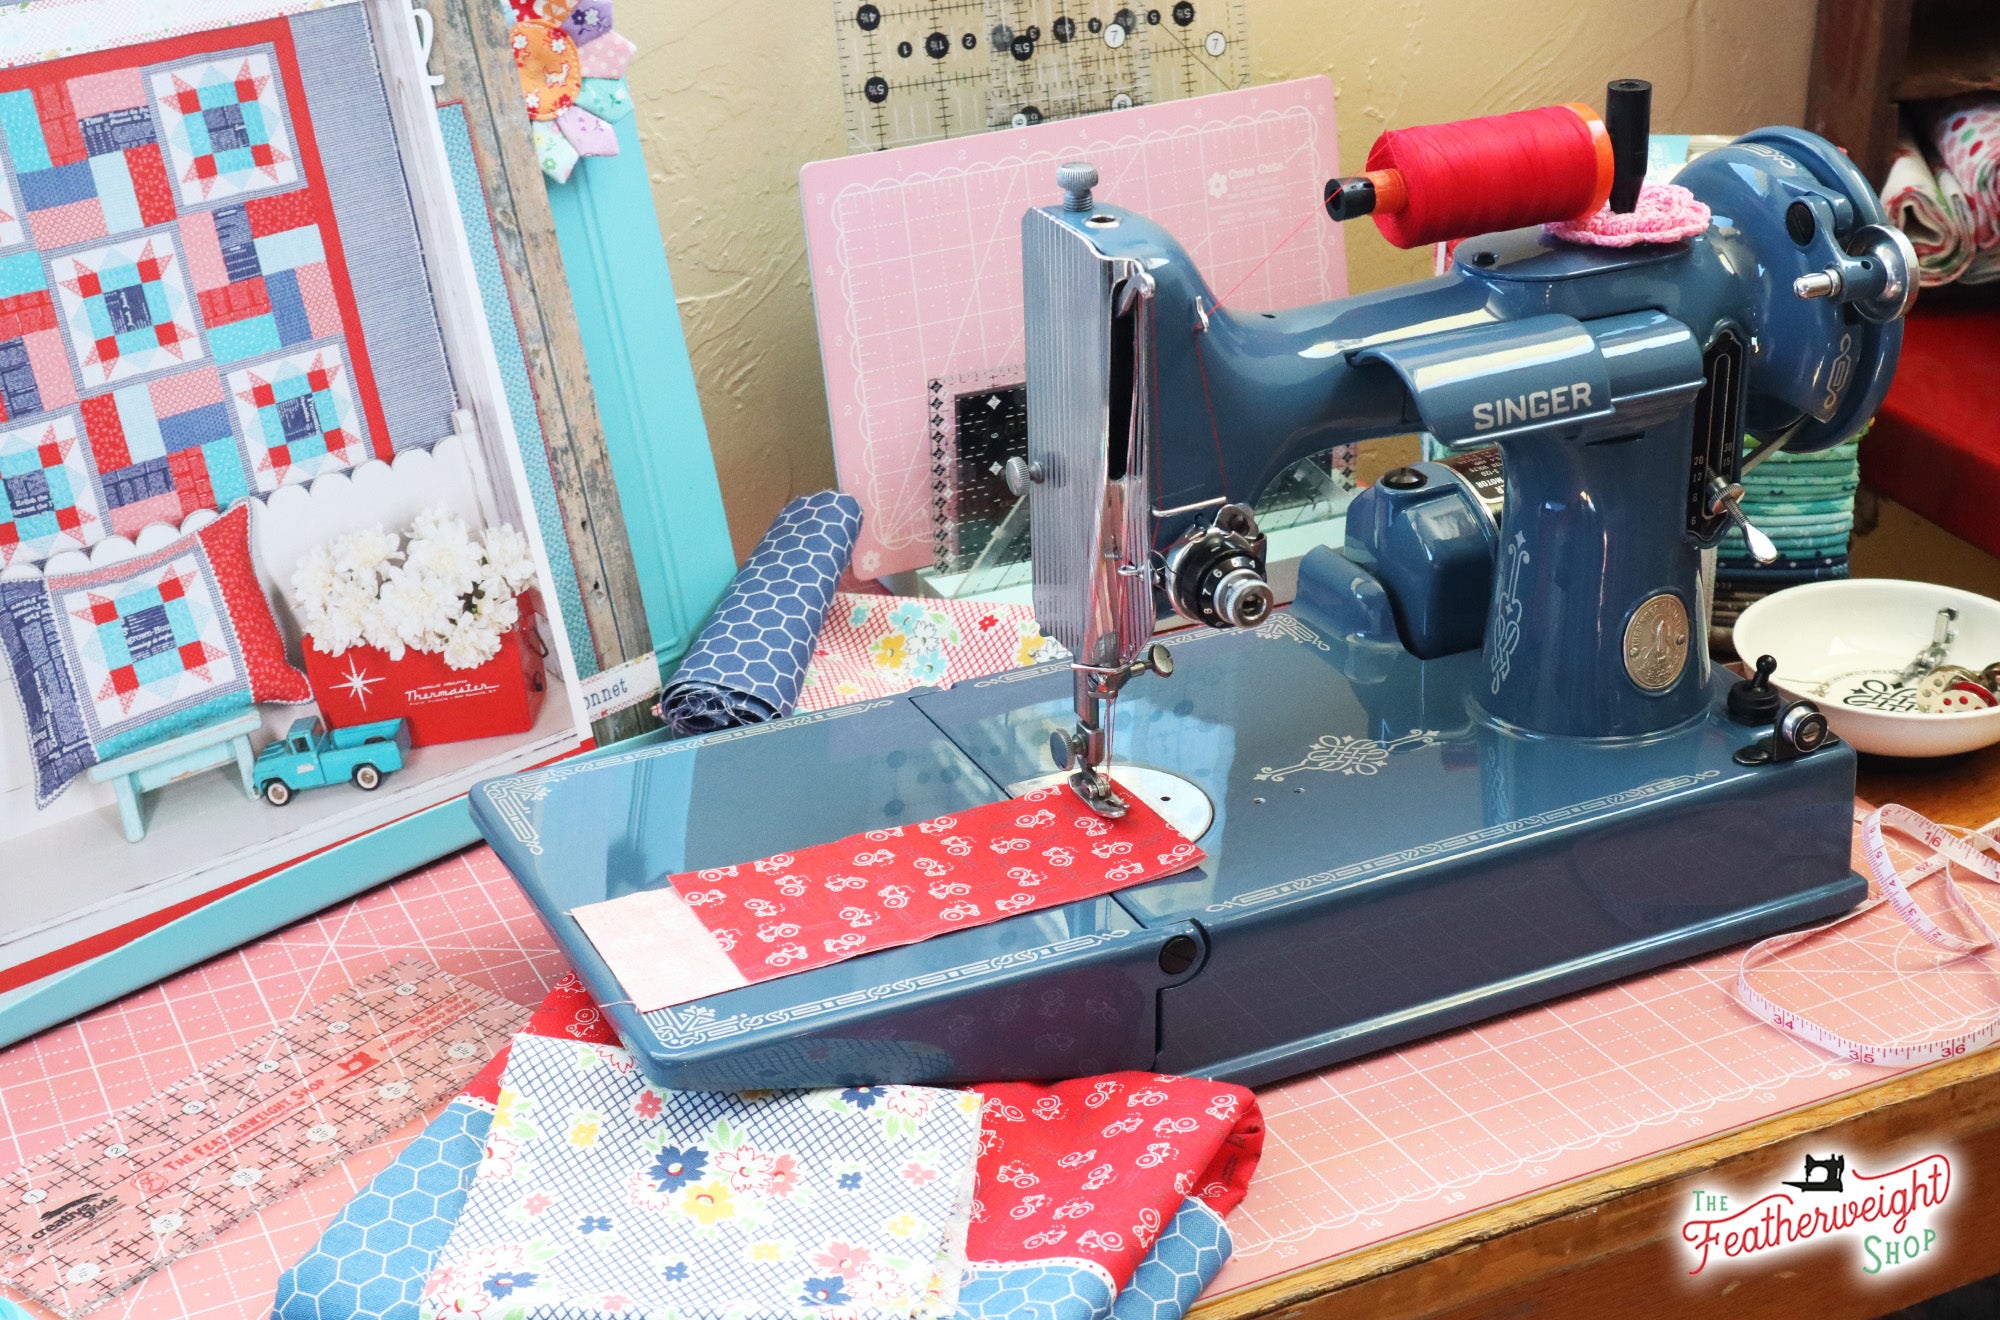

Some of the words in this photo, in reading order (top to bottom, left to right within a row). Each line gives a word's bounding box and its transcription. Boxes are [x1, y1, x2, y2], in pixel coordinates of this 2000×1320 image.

[1472, 382, 1592, 431] SINGER
[1693, 455, 1704, 466] 20
[1475, 476, 1505, 489] MOTOR
[404, 683, 500, 702] Thermaster
[1923, 831, 1943, 848] 16
[1773, 1013, 1794, 1031] 34
[1849, 1049, 1875, 1064] 35
[1941, 1043, 1966, 1059] 36
[1827, 1068, 1852, 1082] 20
[1755, 1092, 1777, 1105] 19
[163, 1154, 195, 1170] THE
[193, 1098, 292, 1156] FEATHERWEIGHT
[290, 1078, 326, 1100] SHOP
[1681, 1115, 1705, 1129] 18
[1603, 1139, 1625, 1154] 17
[1525, 1165, 1548, 1180] 16
[1441, 1190, 1467, 1205] 15
[82, 1194, 119, 1219] grids
[31, 1203, 92, 1240] creative
[1359, 1217, 1385, 1233] 14
[1274, 1245, 1299, 1260] 13
